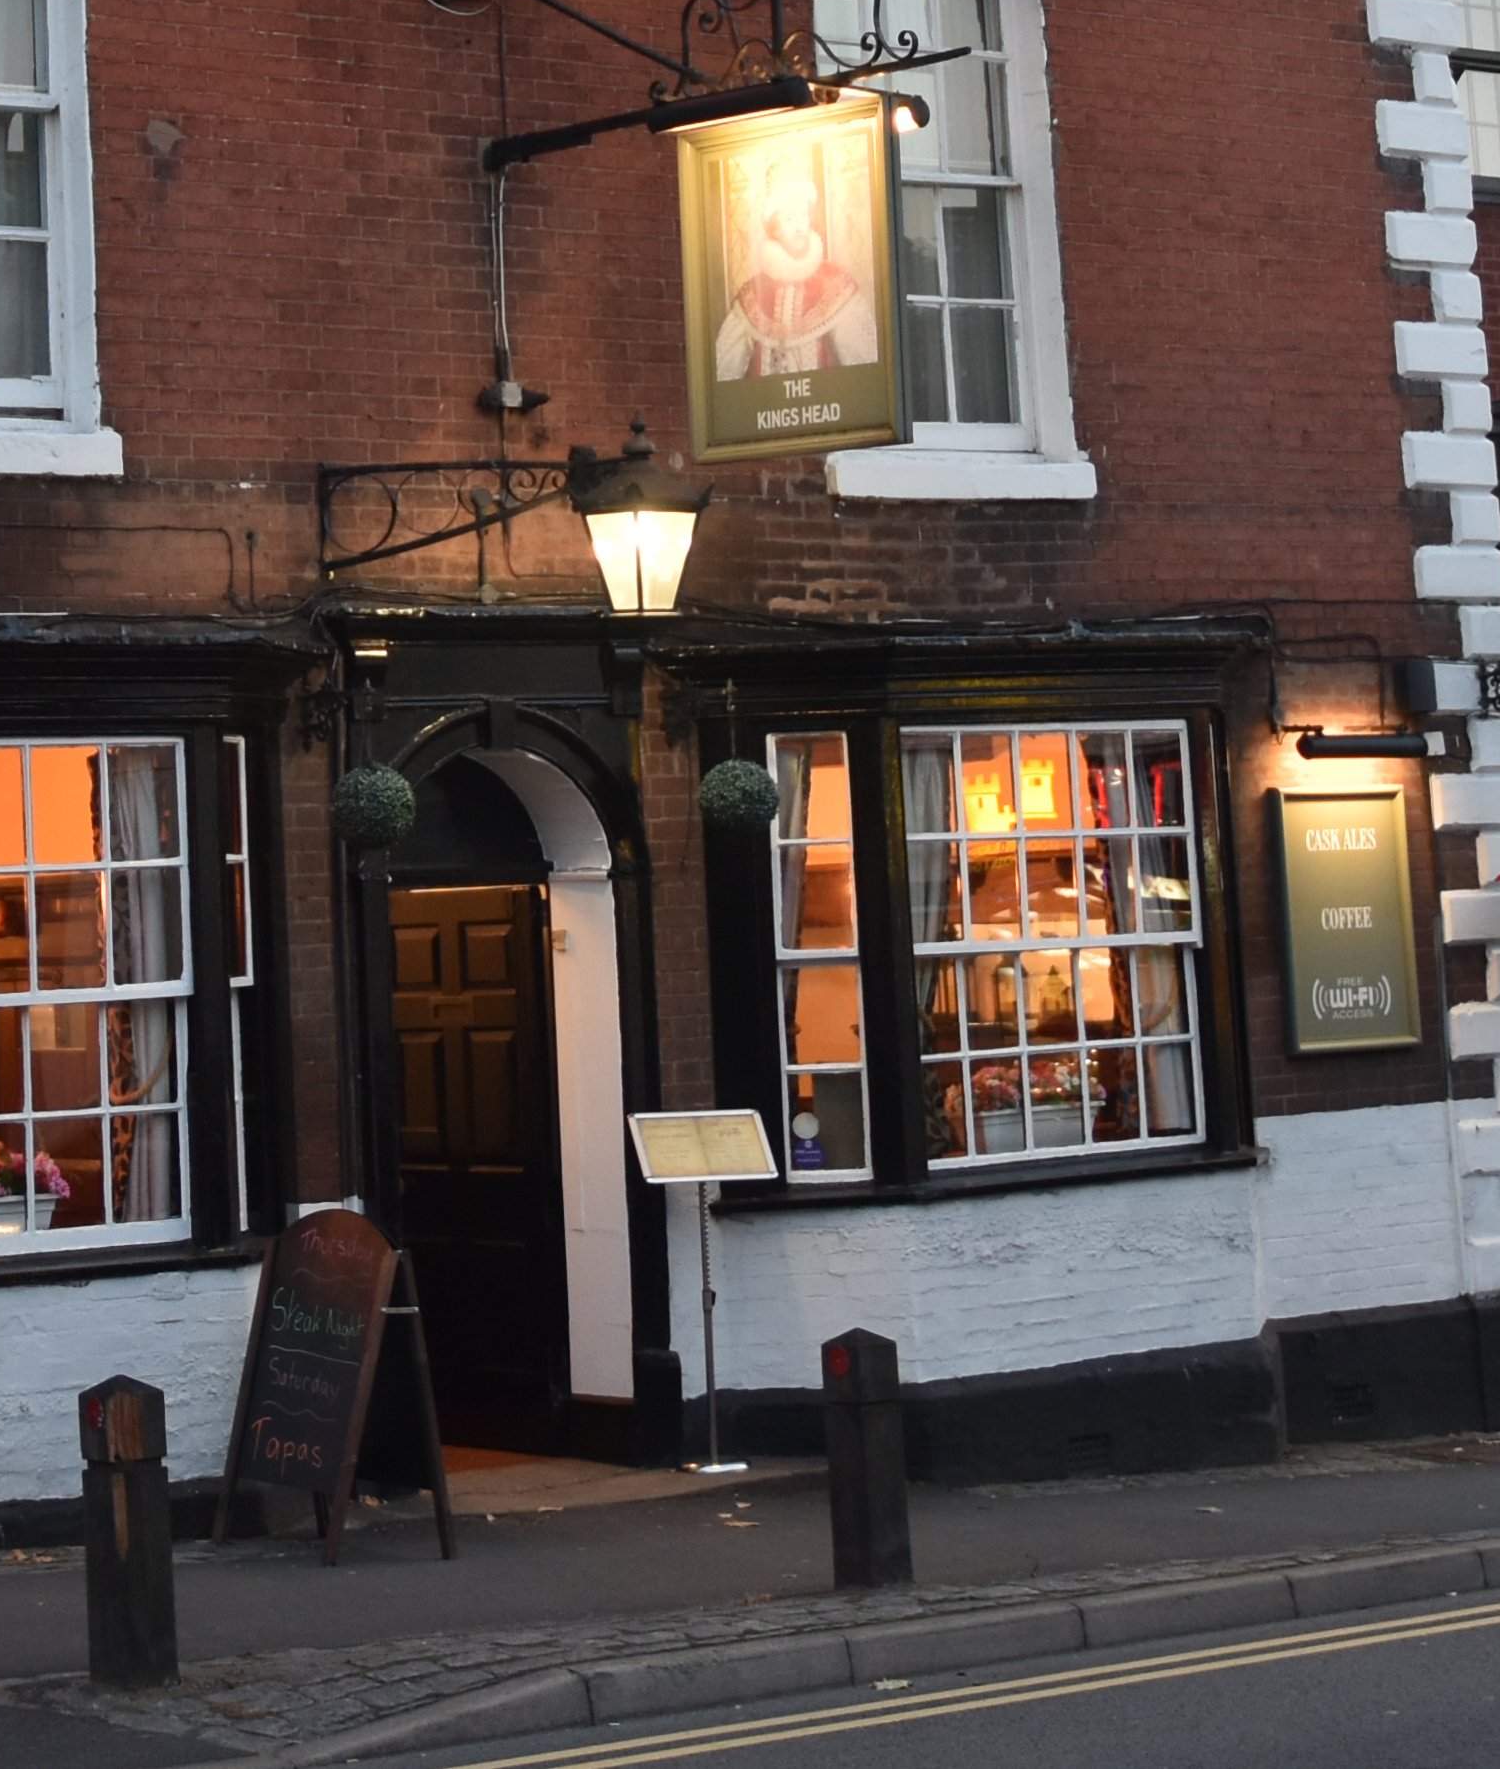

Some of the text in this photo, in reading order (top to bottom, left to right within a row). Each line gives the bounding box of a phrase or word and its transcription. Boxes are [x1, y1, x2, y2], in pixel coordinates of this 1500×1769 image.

[783, 378, 811, 399] THE
[757, 403, 841, 430] KINGS HEAD
[1305, 827, 1377, 851] CASK ALES
[1321, 906, 1373, 930] COFFEE
[1336, 977, 1364, 987] FREE
[1332, 1008, 1375, 1020] ACCESS
[301, 1228, 374, 1276] Thursday
[271, 1287, 366, 1350] Steak Night
[268, 1357, 340, 1404] Saturday
[252, 1416, 323, 1477] Tapas
